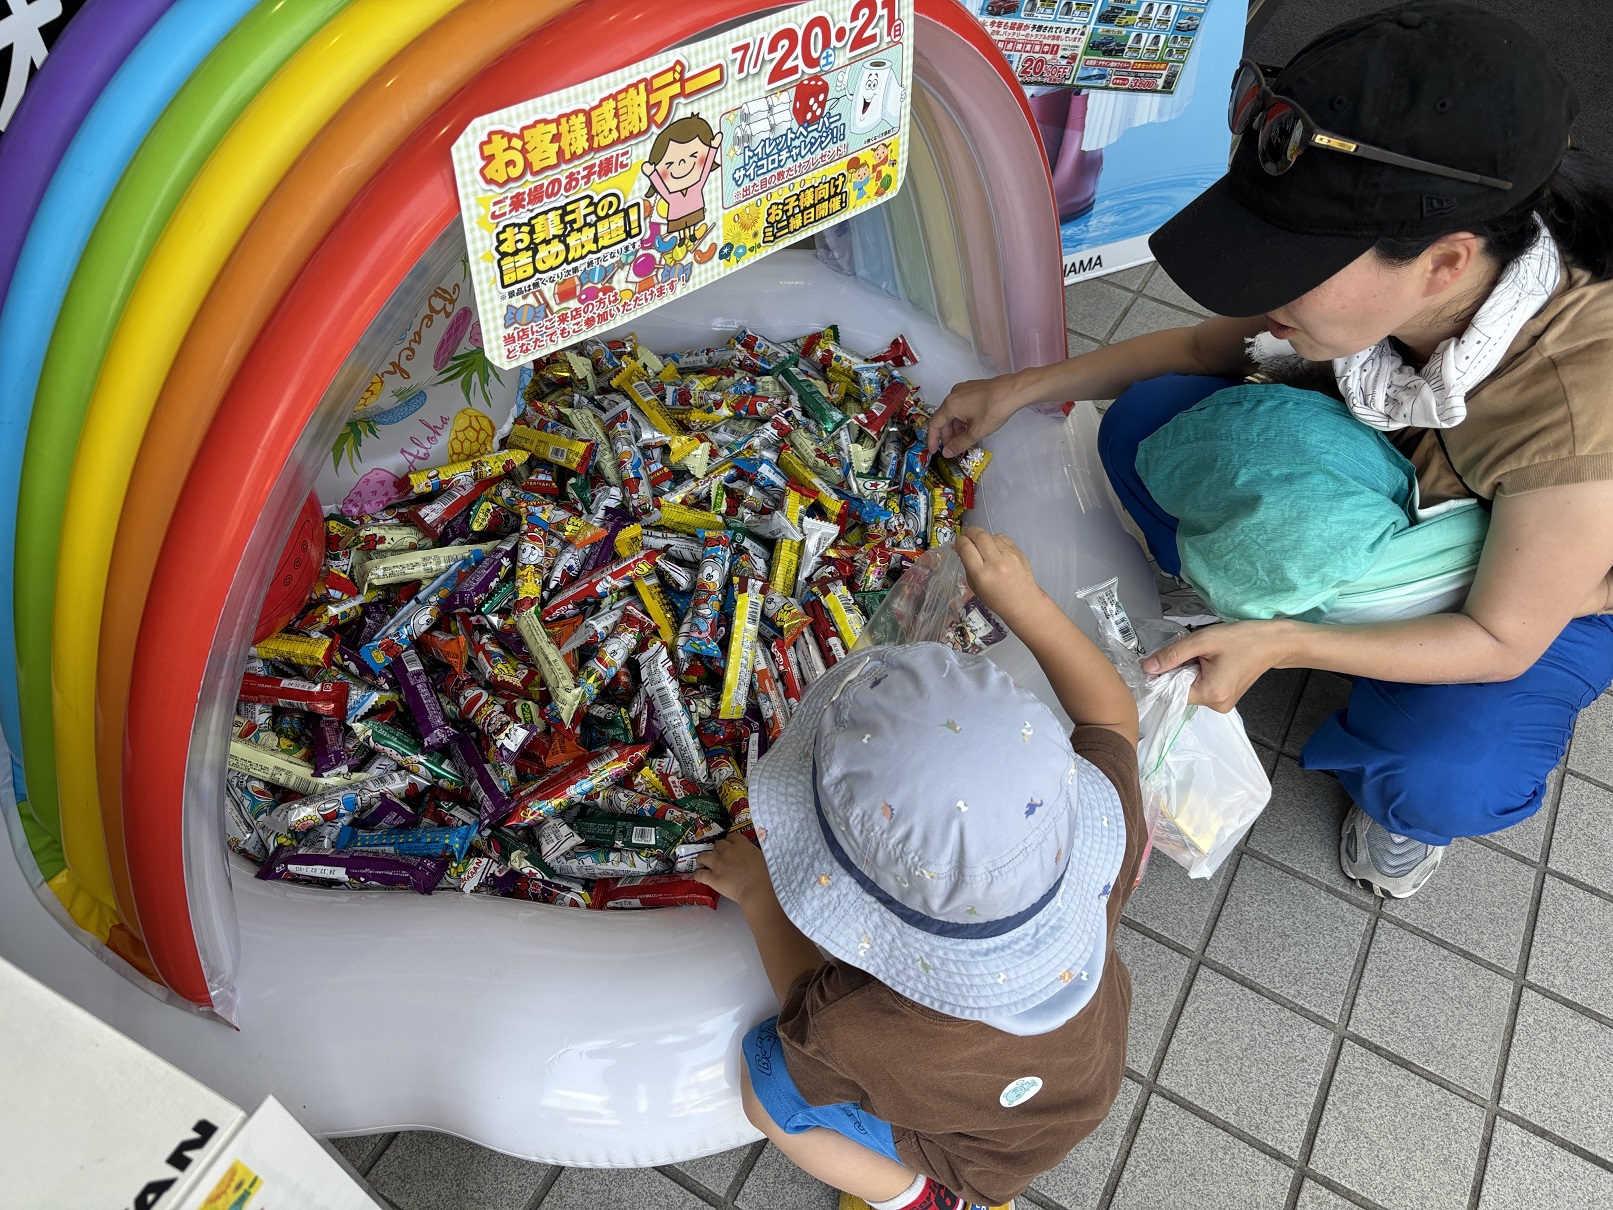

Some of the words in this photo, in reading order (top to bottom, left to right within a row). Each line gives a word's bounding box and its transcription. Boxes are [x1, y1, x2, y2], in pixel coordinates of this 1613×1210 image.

[480, 61, 724, 186] お客様感謝デー
[743, 112, 842, 164] トイレットペーパー
[490, 149, 631, 220] ご来場のお子様に
[766, 173, 847, 224] お子様向け
[498, 192, 621, 253] お菓子の
[500, 202, 643, 288] 詰め放題！
[381, 283, 460, 380] Beach
[503, 291, 620, 346] 当店にご来店の方は
[400, 413, 450, 471] Aloha
